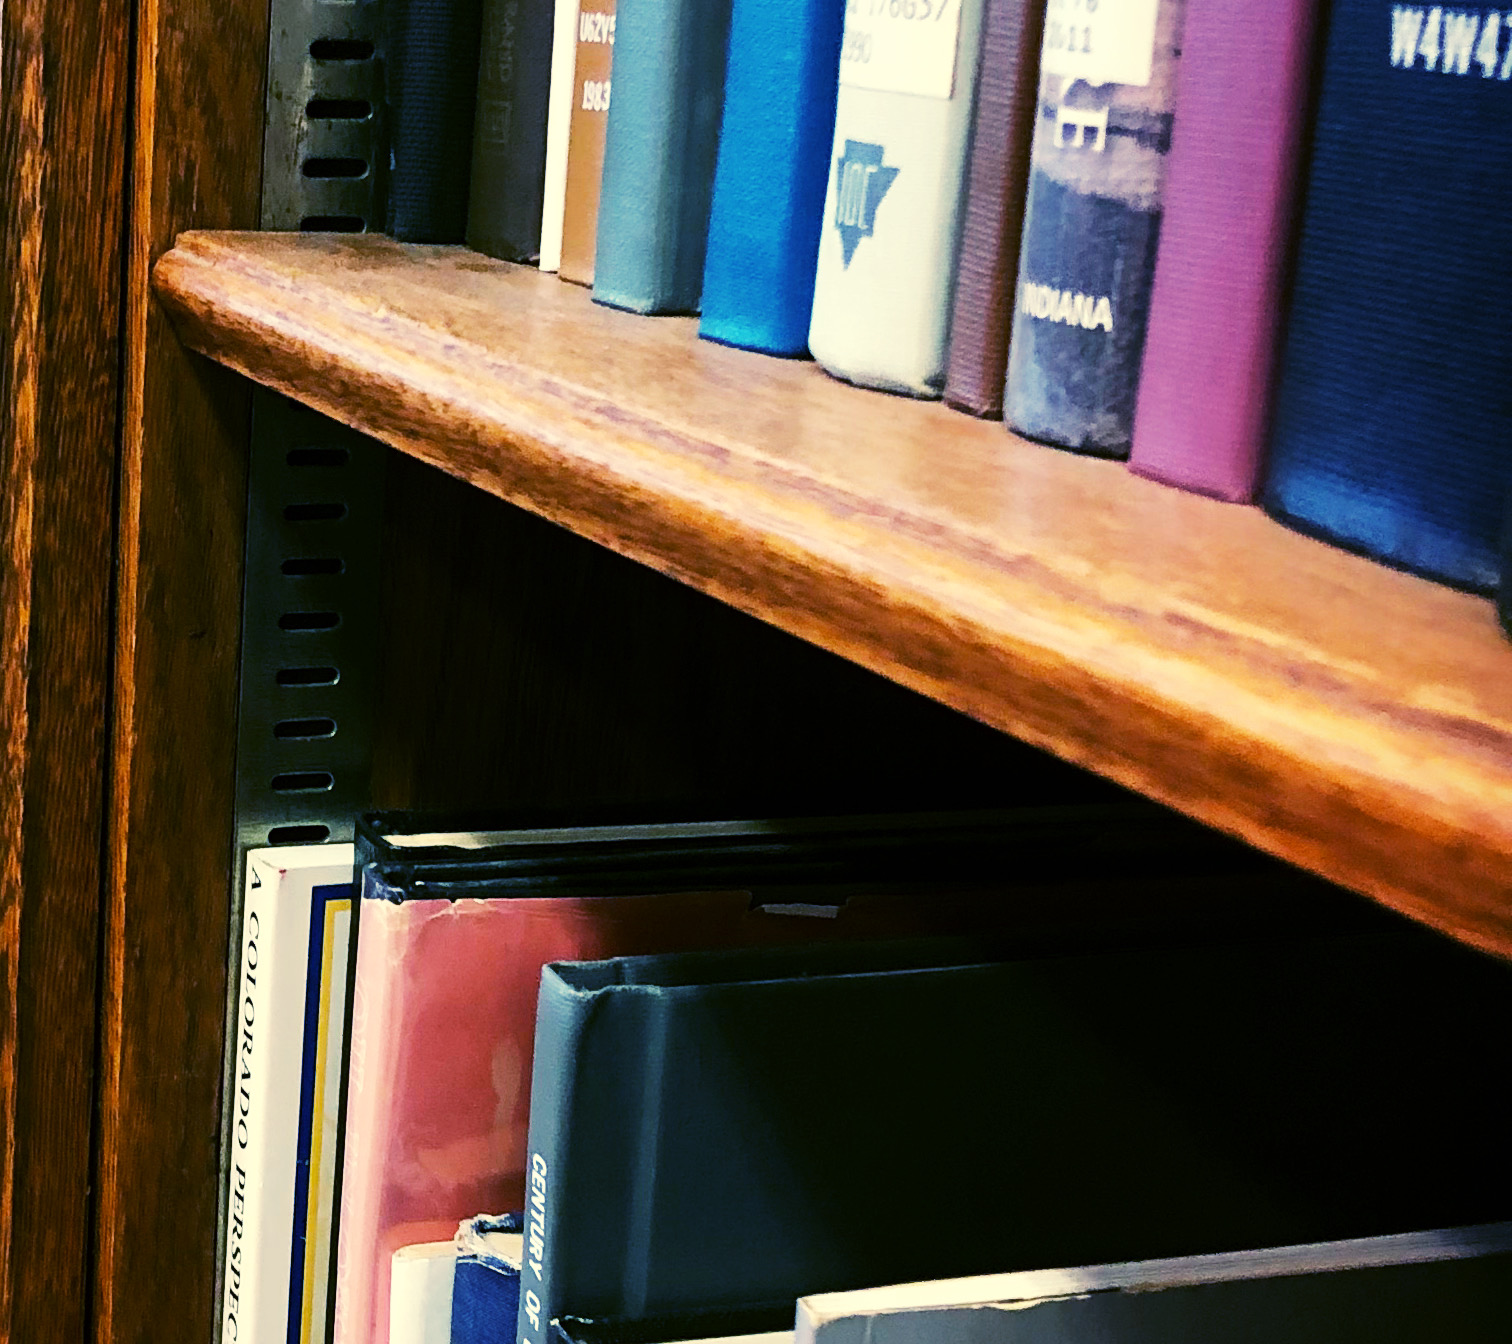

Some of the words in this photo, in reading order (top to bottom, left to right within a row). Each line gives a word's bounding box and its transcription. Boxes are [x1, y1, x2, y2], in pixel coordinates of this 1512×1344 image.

[581, 79, 612, 112] 1983
[249, 867, 264, 891] A
[234, 910, 261, 1154] COLORADO
[529, 1152, 548, 1281] CENTURY
[524, 1289, 540, 1331] OF
